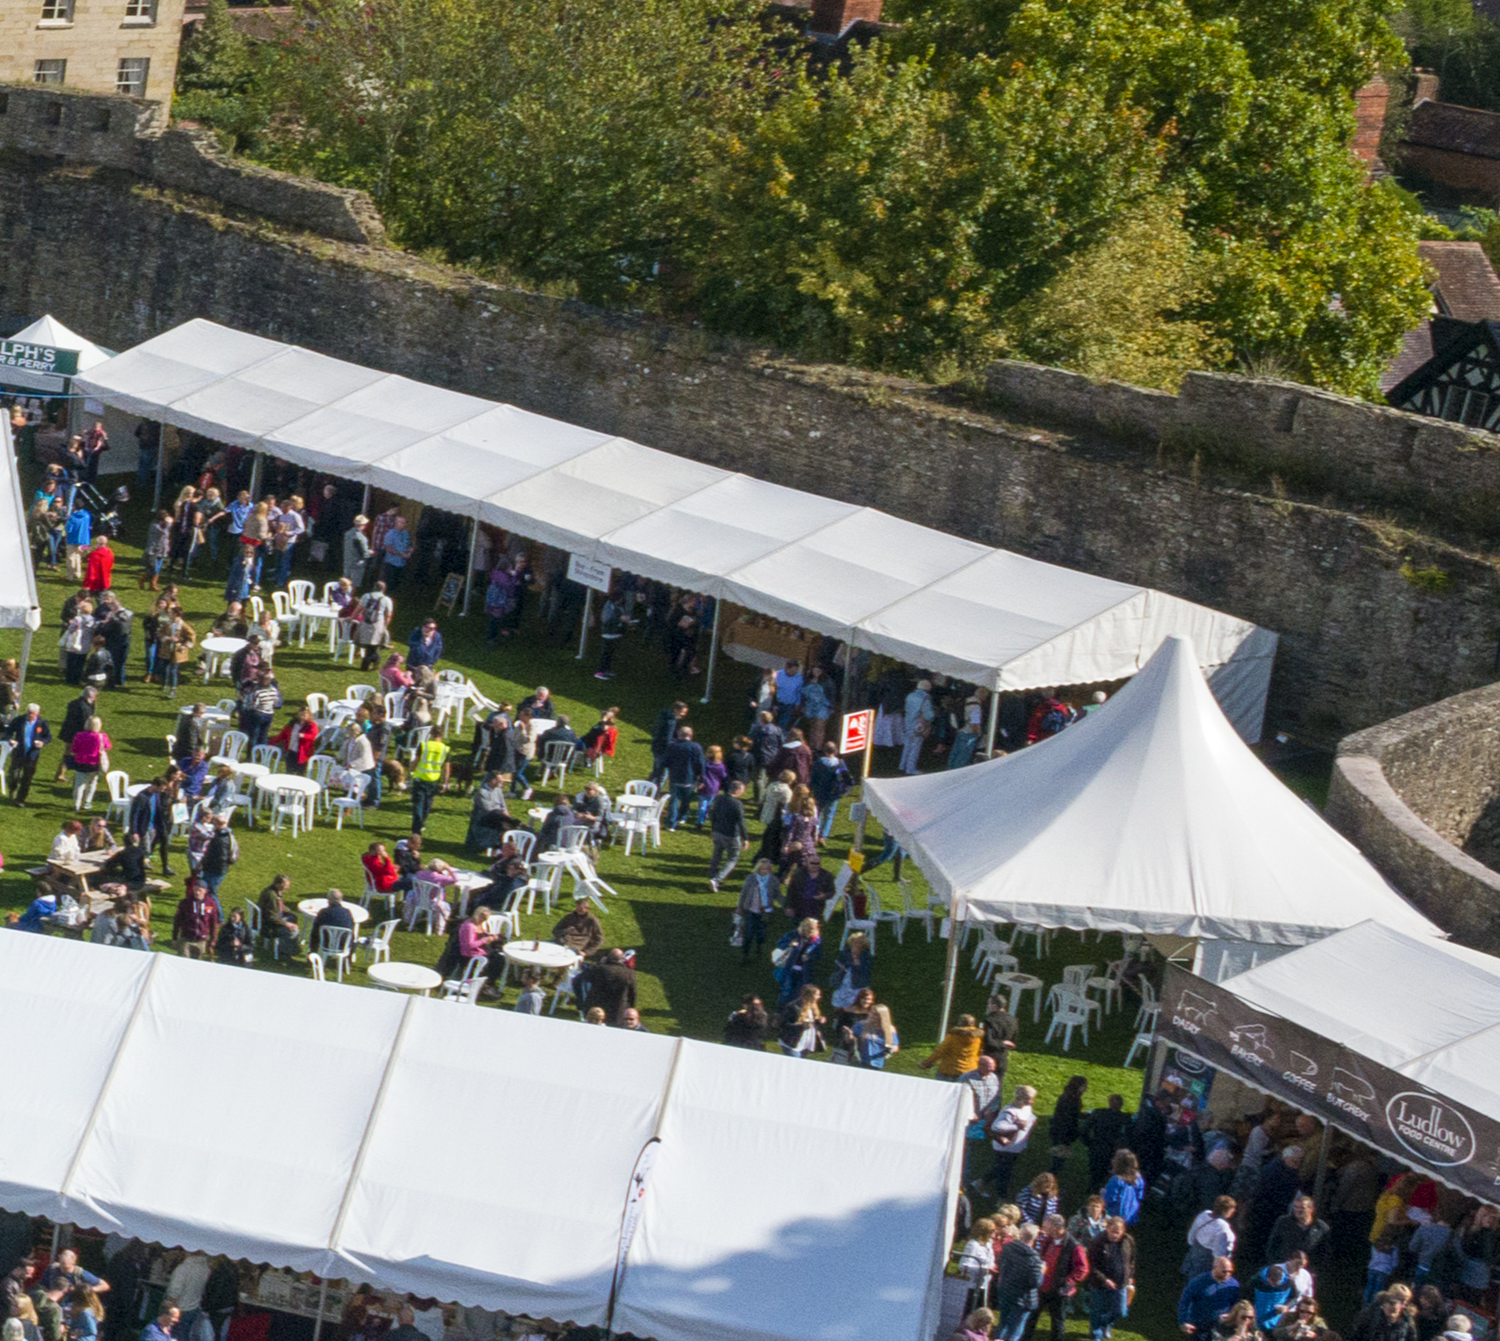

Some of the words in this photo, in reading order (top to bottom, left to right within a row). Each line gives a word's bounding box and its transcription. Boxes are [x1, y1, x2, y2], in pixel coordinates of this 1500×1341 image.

[7, 356, 16, 365] &
[17, 358, 56, 371] PERRY
[1172, 1015, 1201, 1035] DAIRY
[1230, 1043, 1264, 1066] BAKERY
[1282, 1070, 1318, 1093] COFFEE
[1326, 1091, 1371, 1121] BUTCHERY
[1395, 1099, 1465, 1148] Ludlow
[1398, 1124, 1422, 1142] FOOD
[1422, 1135, 1456, 1157] CENTRE
